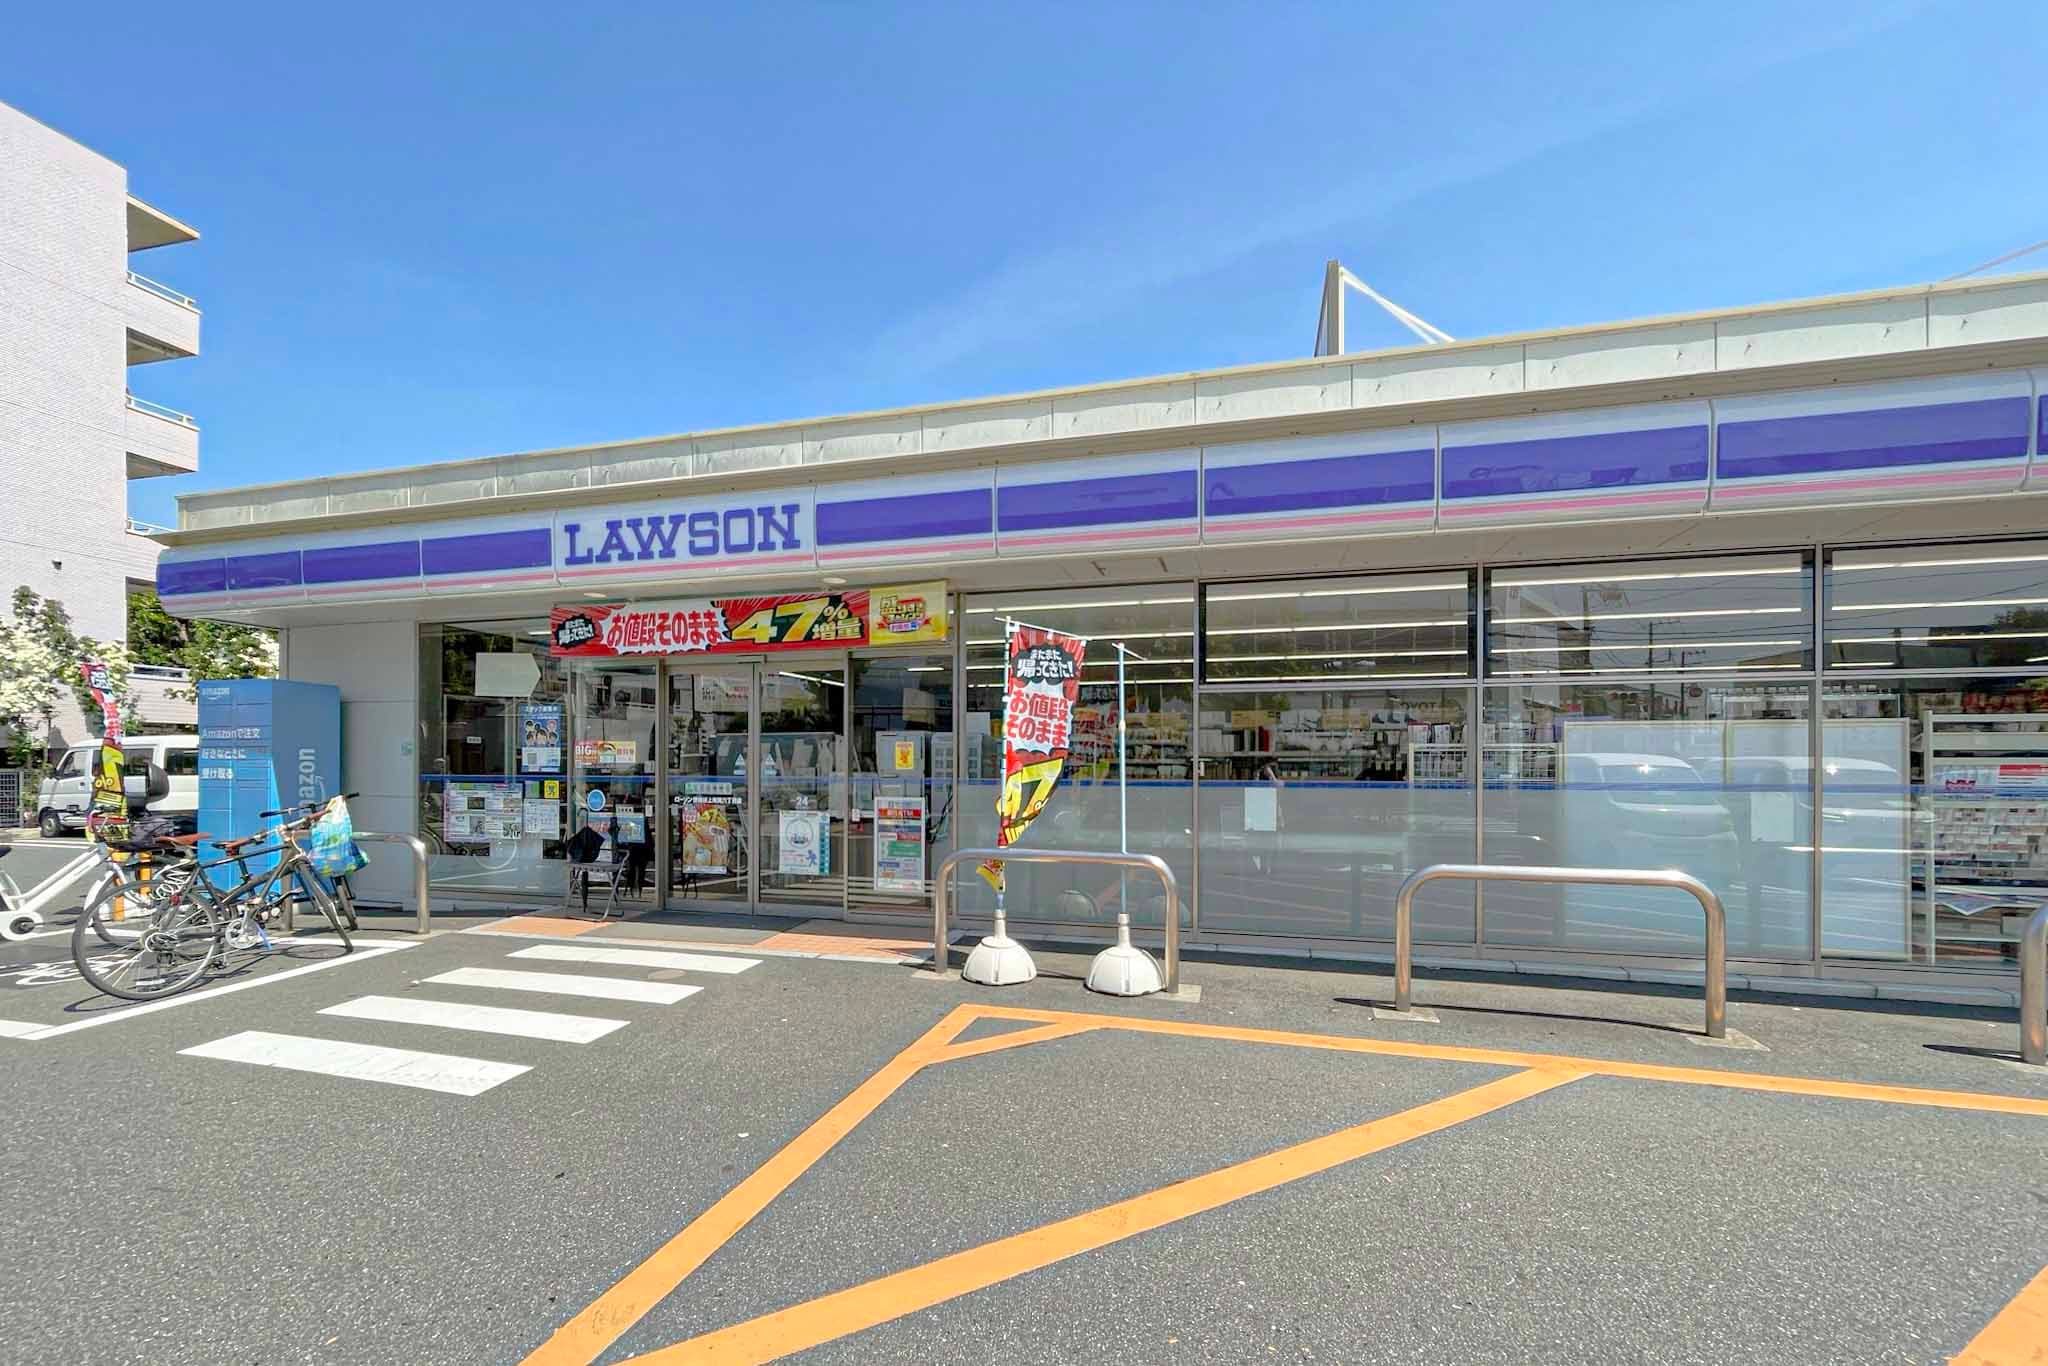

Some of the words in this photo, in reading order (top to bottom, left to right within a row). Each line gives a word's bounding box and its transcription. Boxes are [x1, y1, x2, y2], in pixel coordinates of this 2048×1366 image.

[564, 503, 801, 566] LAWSON
[606, 609, 721, 649] お値段そのまま
[812, 617, 862, 641] 増量
[1030, 649, 1062, 660] またまた
[1010, 691, 1070, 722] お値段
[202, 728, 261, 739] Amazonで注文
[1006, 716, 1067, 747] そのまま
[575, 745, 592, 756] BIG
[299, 748, 316, 808] azon
